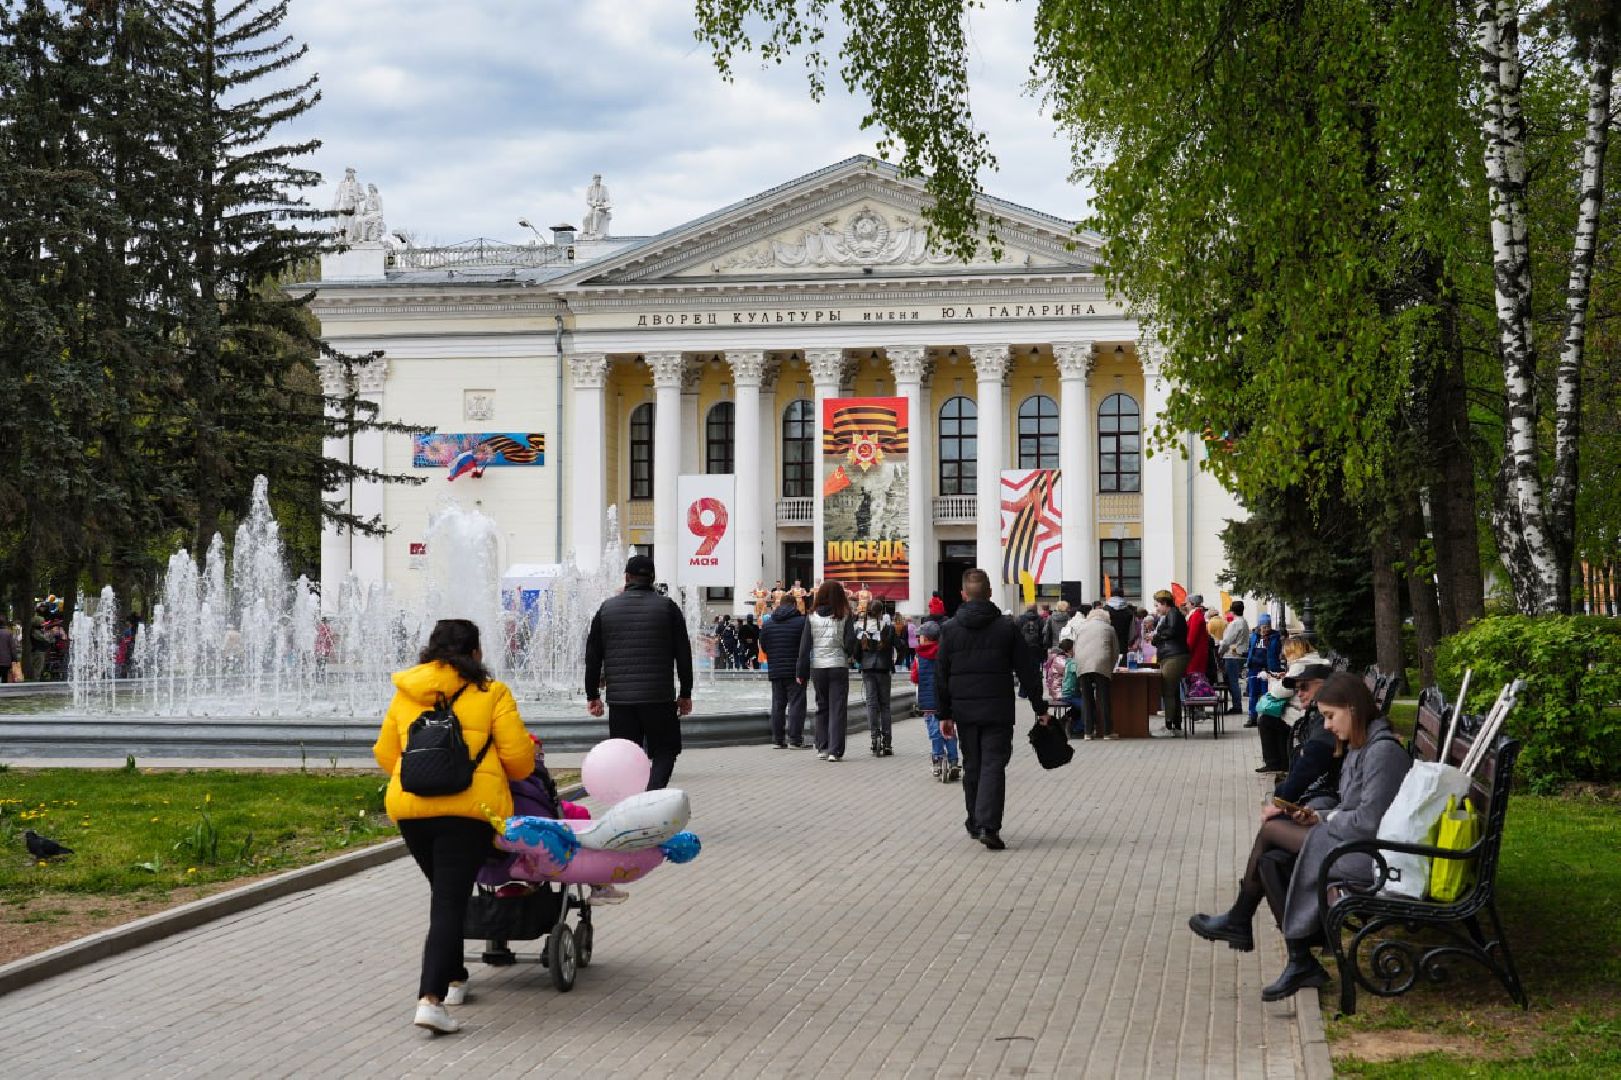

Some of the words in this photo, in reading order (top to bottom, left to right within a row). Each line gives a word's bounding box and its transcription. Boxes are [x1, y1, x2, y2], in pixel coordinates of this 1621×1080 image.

[637, 312, 717, 326] ДВОРЕЦ
[733, 310, 841, 323] КУЛЬТУРЫ
[989, 304, 1096, 317] ГАГАРИНА
[687, 497, 728, 555] 9
[827, 539, 906, 565] ПОБЕДА
